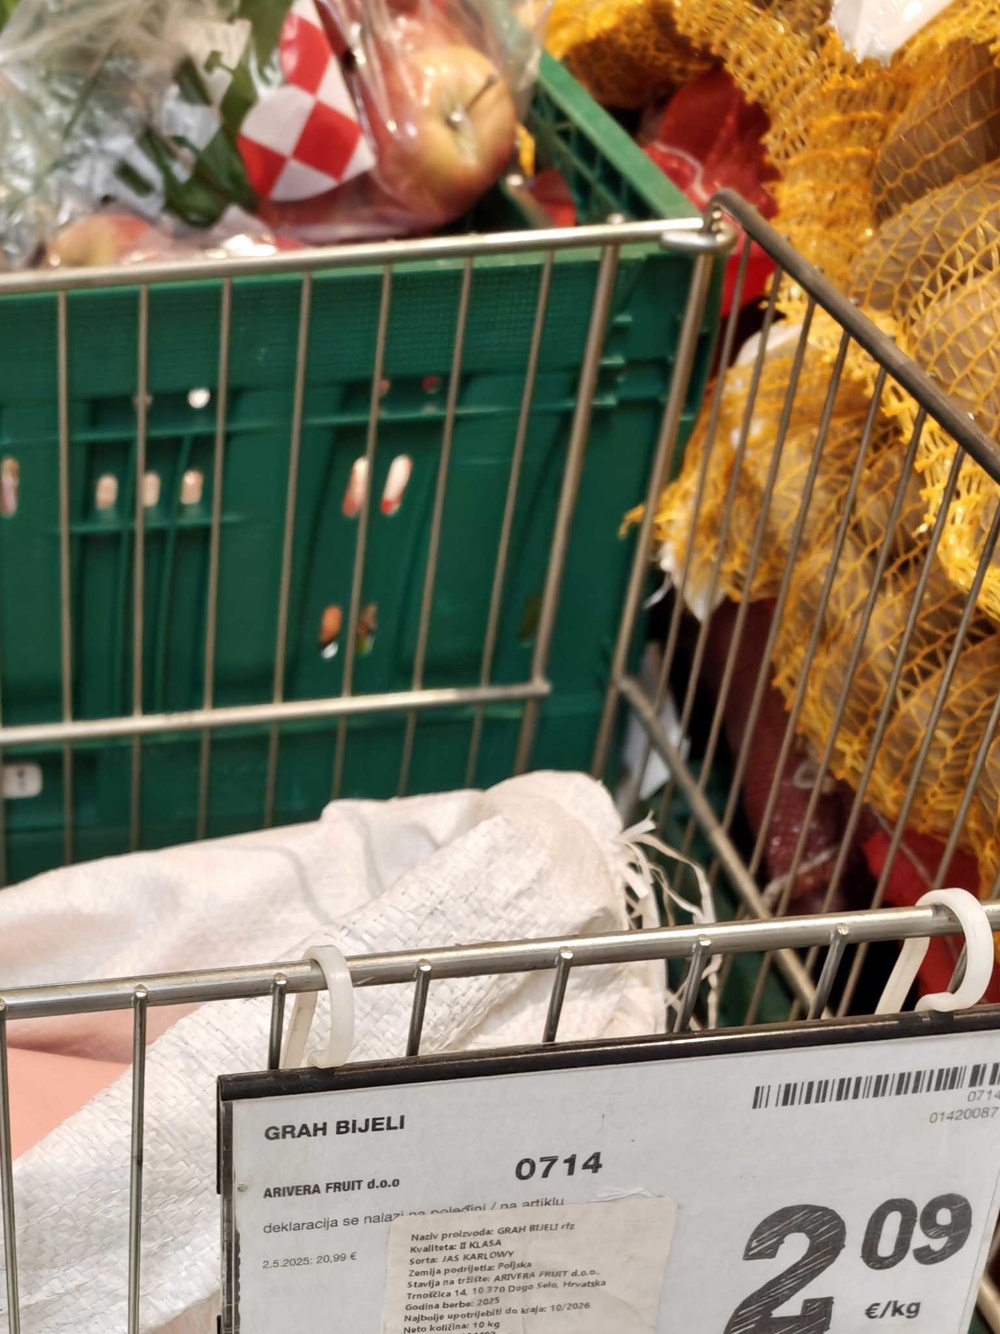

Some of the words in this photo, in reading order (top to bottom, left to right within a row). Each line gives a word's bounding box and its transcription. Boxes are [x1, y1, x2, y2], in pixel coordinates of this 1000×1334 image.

[967, 1089, 1000, 1102] 0714
[929, 1106, 1000, 1124] 01420087
[264, 1122, 328, 1140] GRAH
[336, 1115, 405, 1135] BIJELI
[515, 1152, 603, 1181] 0714
[263, 1184, 321, 1199] ARIVERA
[326, 1179, 363, 1193] FRUIT
[367, 1178, 400, 1189] d.o.o
[263, 1218, 339, 1234] deklaracija
[343, 1216, 359, 1227] se
[522, 1197, 564, 1208] artiklu
[411, 1232, 438, 1241] Naziv
[441, 1228, 494, 1241] proizvoda:
[497, 1225, 526, 1235] GRAH
[529, 1223, 559, 1232] BIJELI
[861, 1193, 972, 1270] 09
[410, 1244, 457, 1253] Kvaliteta:
[469, 1240, 501, 1249] KLASA
[262, 1257, 313, 1269] 2.5.2025:
[316, 1252, 347, 1265] 20,99
[350, 1252, 357, 1261] €
[409, 1257, 438, 1265] Sorta:
[442, 1254, 459, 1262] JAS
[463, 1250, 514, 1261] KARLOWY
[408, 1268, 441, 1277] Zemlja
[444, 1265, 495, 1275] podrijetla:
[498, 1261, 531, 1270] Poljska
[407, 1279, 440, 1288] Stavlja
[443, 1278, 454, 1286] na
[494, 1272, 535, 1282] ARIVERA
[539, 1270, 568, 1278] FRUIT
[508, 1284, 533, 1293] Dugo
[537, 1281, 558, 1289] Selo,
[563, 1280, 606, 1288] Hrvatska
[404, 1313, 444, 1323] Najbolje
[447, 1308, 502, 1321] upotrijebiti
[521, 1305, 547, 1314] kraja:
[550, 1302, 590, 1312] 10/2026
[405, 1303, 439, 1311] Godina
[442, 1300, 473, 1309] berbe:
[477, 1297, 500, 1306] 2025
[865, 1299, 920, 1319] €/kg
[403, 1325, 427, 1334] Neto
[473, 1321, 484, 1329] 10
[487, 1321, 500, 1329] kg
